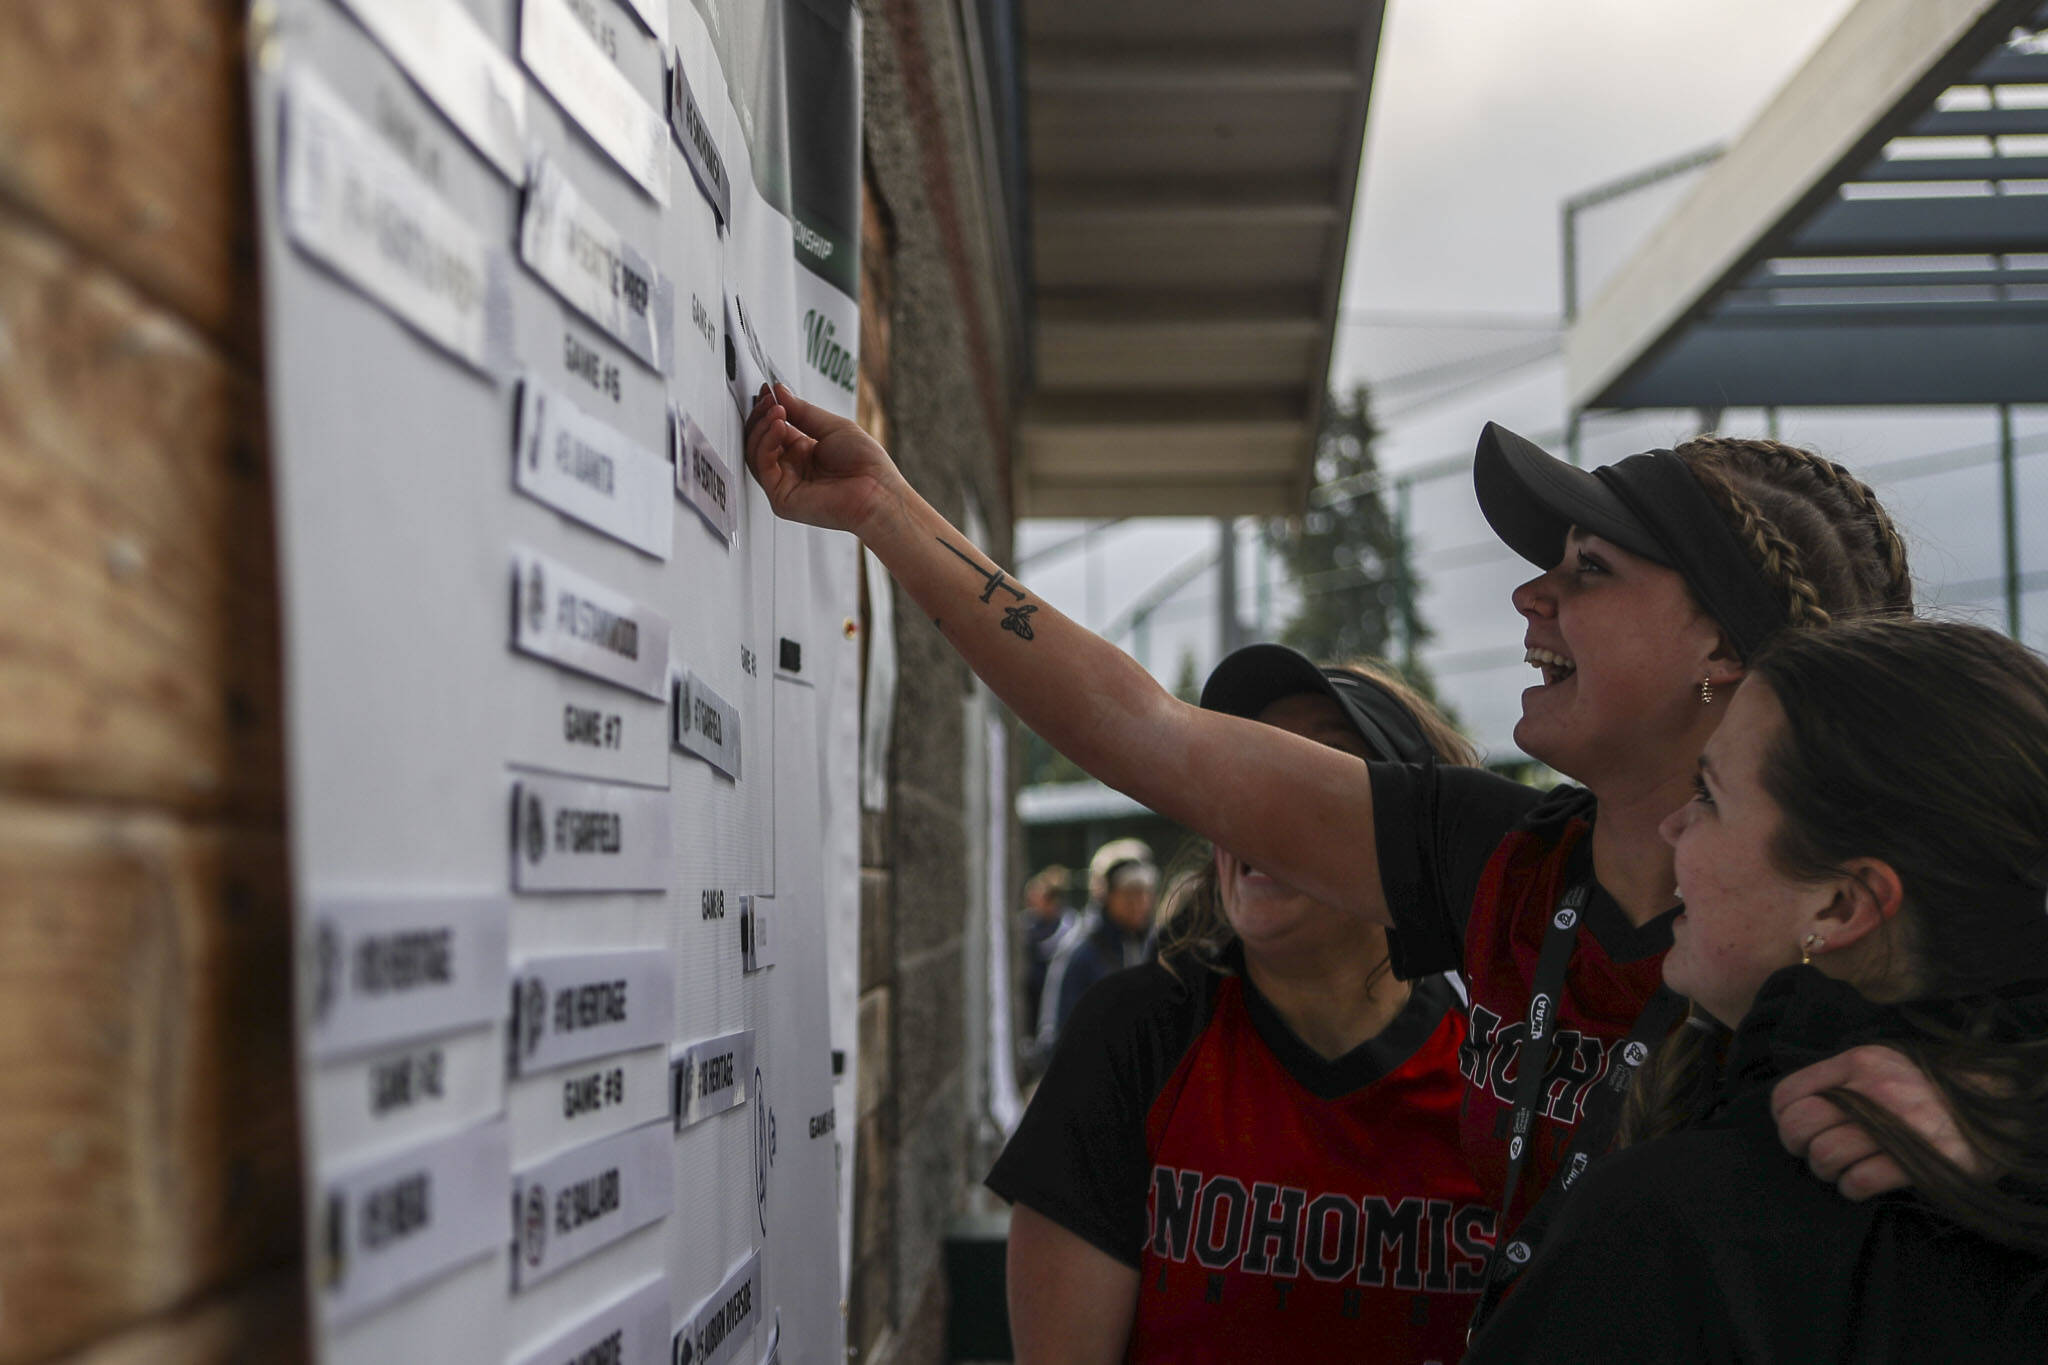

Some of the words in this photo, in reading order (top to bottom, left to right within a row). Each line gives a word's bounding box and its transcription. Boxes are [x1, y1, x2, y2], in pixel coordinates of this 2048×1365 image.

[565, 332, 601, 390] GAME
[565, 703, 601, 748] GAME
[604, 714, 621, 751] #7
[702, 888, 717, 921] GAME
[1531, 1000, 1547, 1040] WIAA
[708, 1052, 733, 1093] HERITAGE
[564, 1073, 600, 1120] GAME
[1143, 1165, 1499, 1294] NOHOMIS
[725, 1276, 752, 1338] RIVERSIDE
